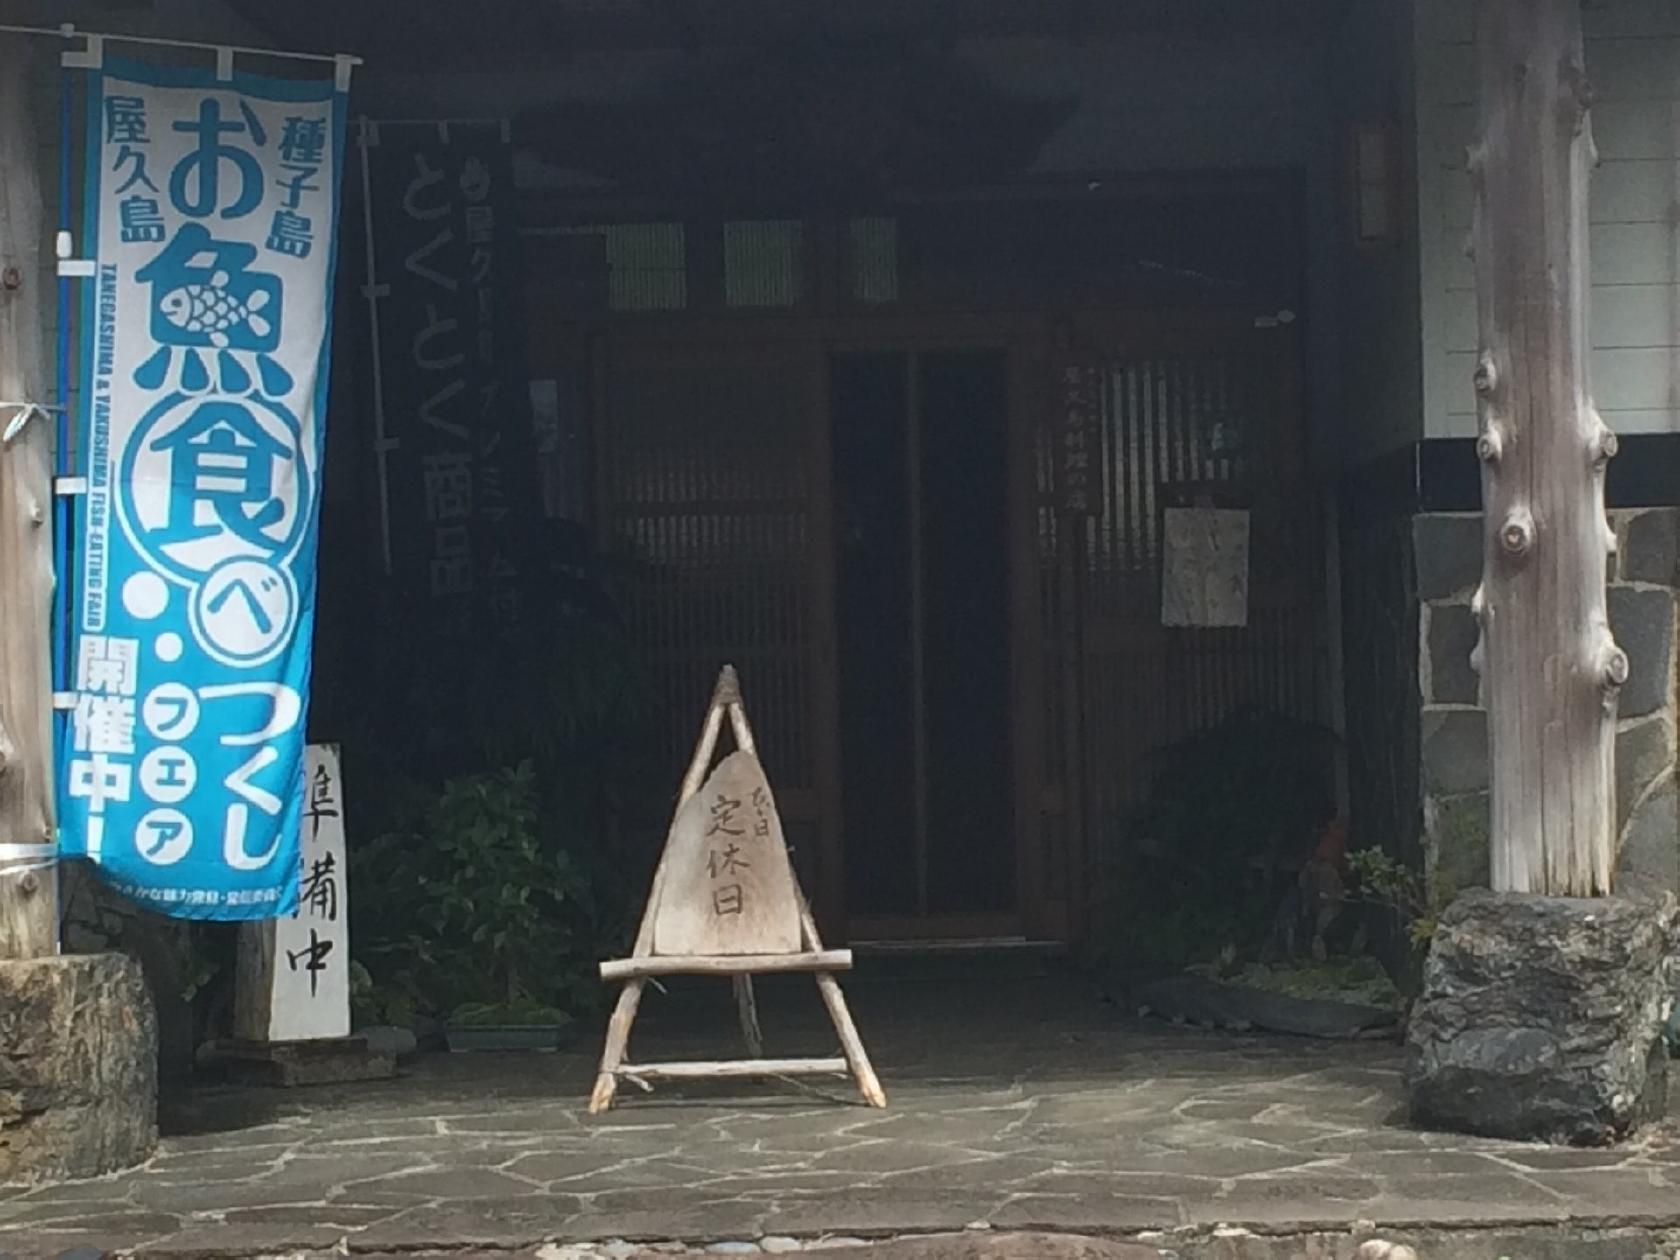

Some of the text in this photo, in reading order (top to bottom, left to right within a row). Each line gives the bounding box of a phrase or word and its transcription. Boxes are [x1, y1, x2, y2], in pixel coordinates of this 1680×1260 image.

[103, 96, 166, 242] 屋久島
[266, 115, 327, 259] 種子島
[98, 264, 117, 375] TANEGASHIMA
[93, 395, 111, 487] YAKUSHIMA
[706, 795, 751, 916] 定休日
